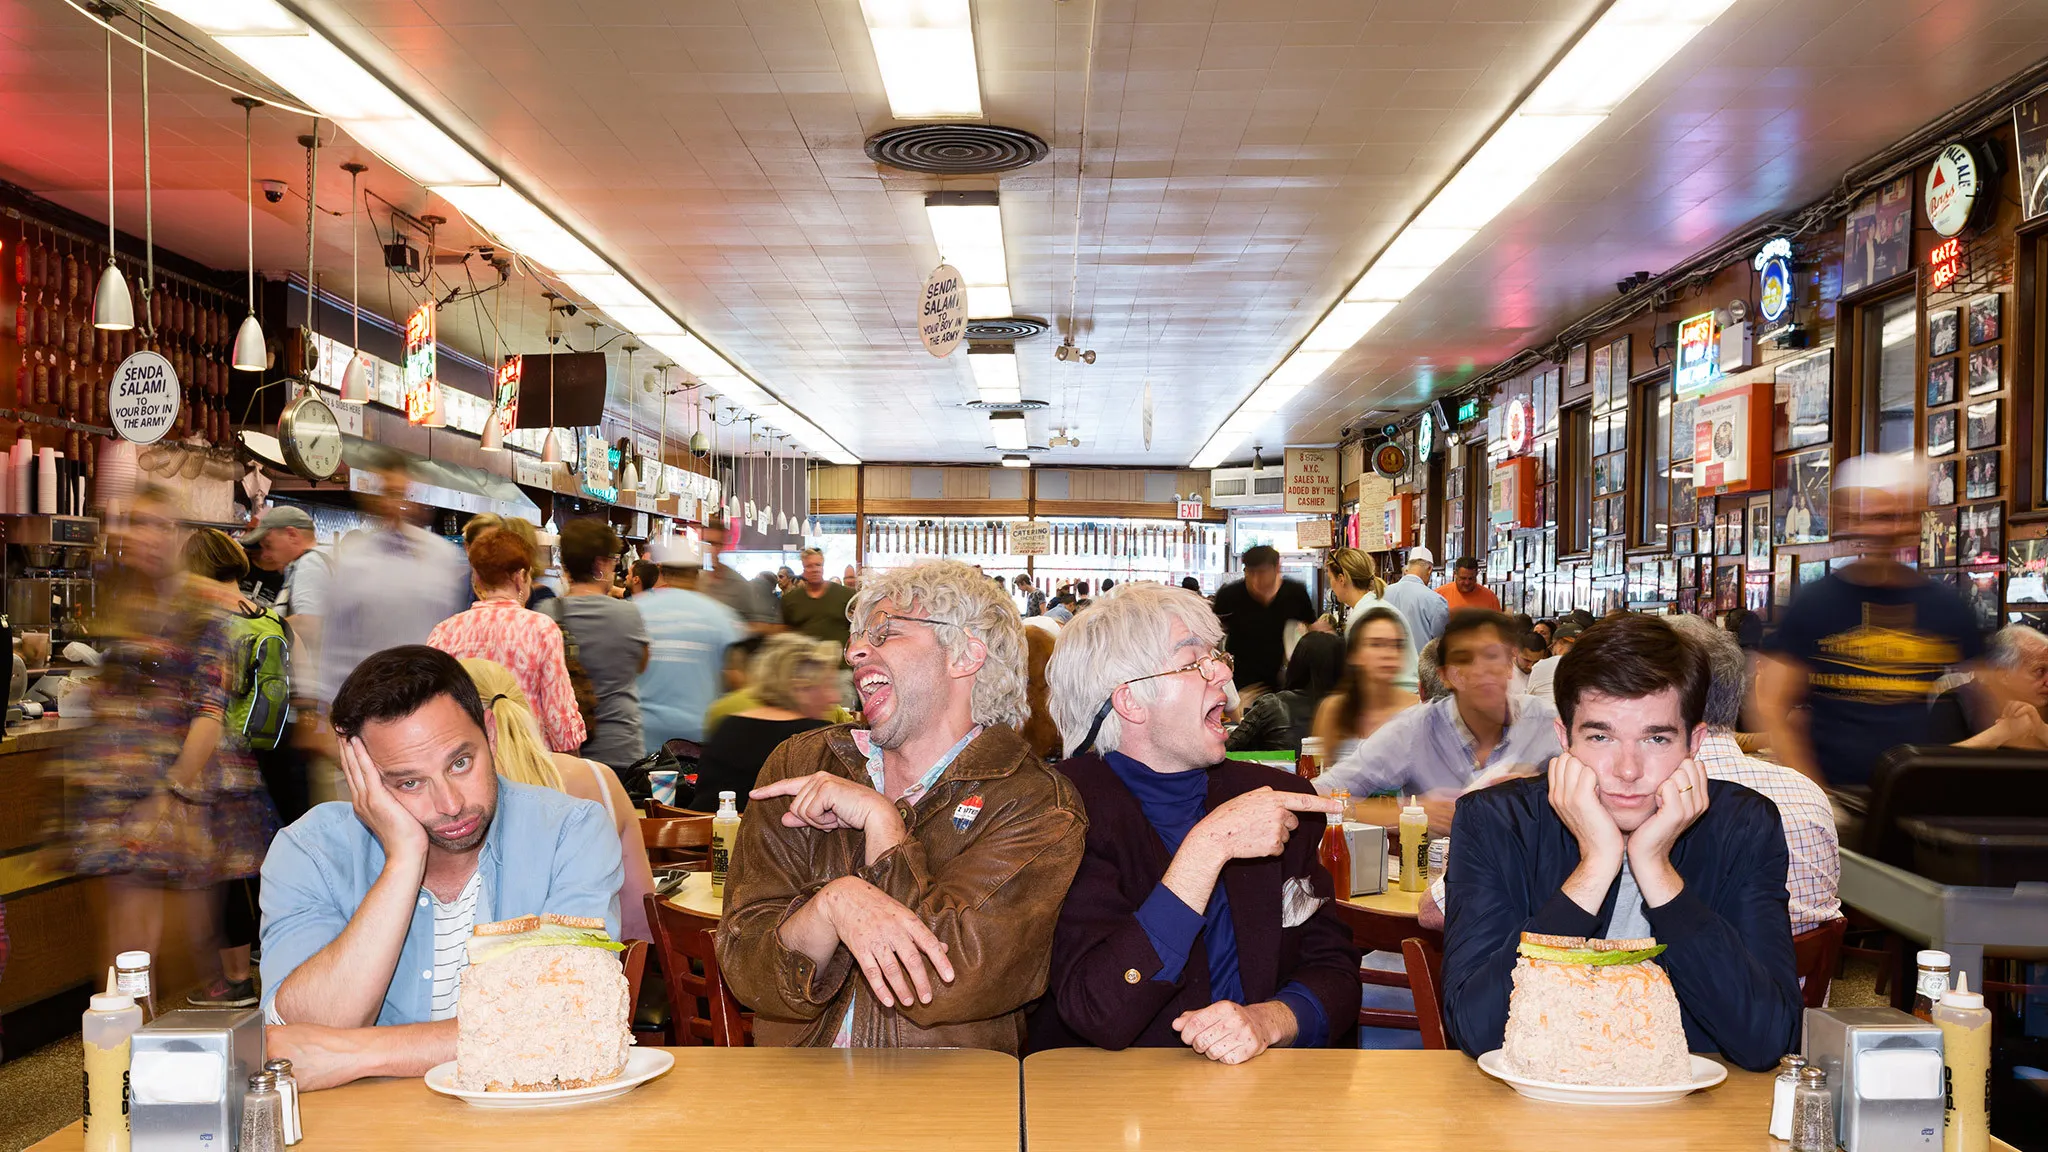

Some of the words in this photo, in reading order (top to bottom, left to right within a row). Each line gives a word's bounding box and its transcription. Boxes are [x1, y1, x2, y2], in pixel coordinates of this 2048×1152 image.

[1944, 146, 1966, 165] PALE
[1930, 183, 1955, 222] Bass
[1931, 239, 1958, 265] KATZ
[1933, 259, 1957, 287] DELI
[927, 277, 957, 300] SENDA
[924, 294, 959, 316] SALAMI
[938, 312, 947, 322] TO
[923, 322, 940, 335] YOUR
[940, 319, 953, 332] BOY
[955, 316, 963, 327] IN
[930, 335, 940, 346] THE
[940, 330, 960, 344] ARMY
[124, 365, 163, 382] SENDA
[119, 379, 166, 397] SALAMI
[136, 397, 148, 405] TO
[335, 401, 349, 411] SIDES
[349, 404, 361, 415] HERE
[115, 407, 140, 418] YOUR
[140, 405, 160, 416] BOY
[162, 404, 173, 414] IN
[123, 419, 139, 429] THE
[140, 416, 167, 428] ARMY
[1303, 464, 1320, 473] N.Y.C.
[1294, 476, 1315, 484] SALES
[1317, 476, 1329, 484] TAX
[1288, 486, 1310, 495] ADDED
[1312, 486, 1320, 495] BY
[1323, 487, 1335, 495] THE
[1298, 498, 1325, 506] CASHIER
[1181, 503, 1200, 518] EXIT
[1012, 528, 1048, 537] CATERING
